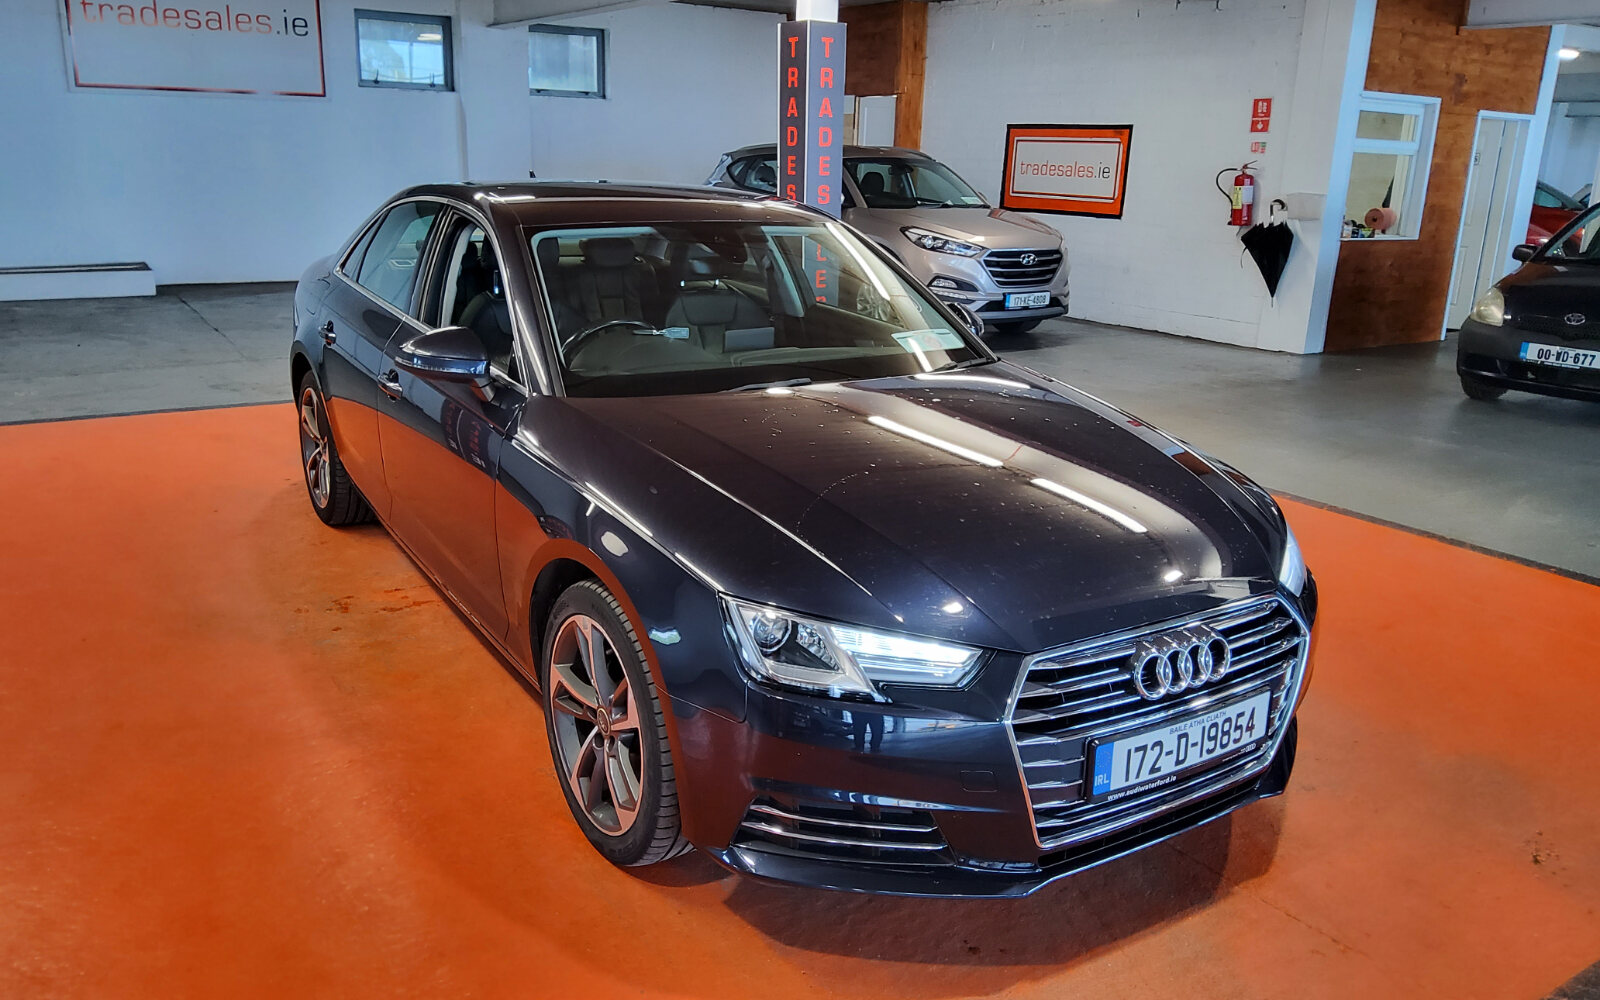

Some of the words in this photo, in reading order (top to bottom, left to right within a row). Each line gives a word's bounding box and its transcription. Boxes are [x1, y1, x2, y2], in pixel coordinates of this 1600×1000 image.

[80, 0, 309, 37] tradesales.ie
[1019, 160, 1111, 180] tradesales.ie
[1537, 348, 1597, 366] 00-WD-677
[1169, 724, 1189, 735] BAILE
[1206, 710, 1227, 722] CLIATH
[1124, 706, 1256, 783] 172-D-19854
[1094, 773, 1110, 787] IRL
